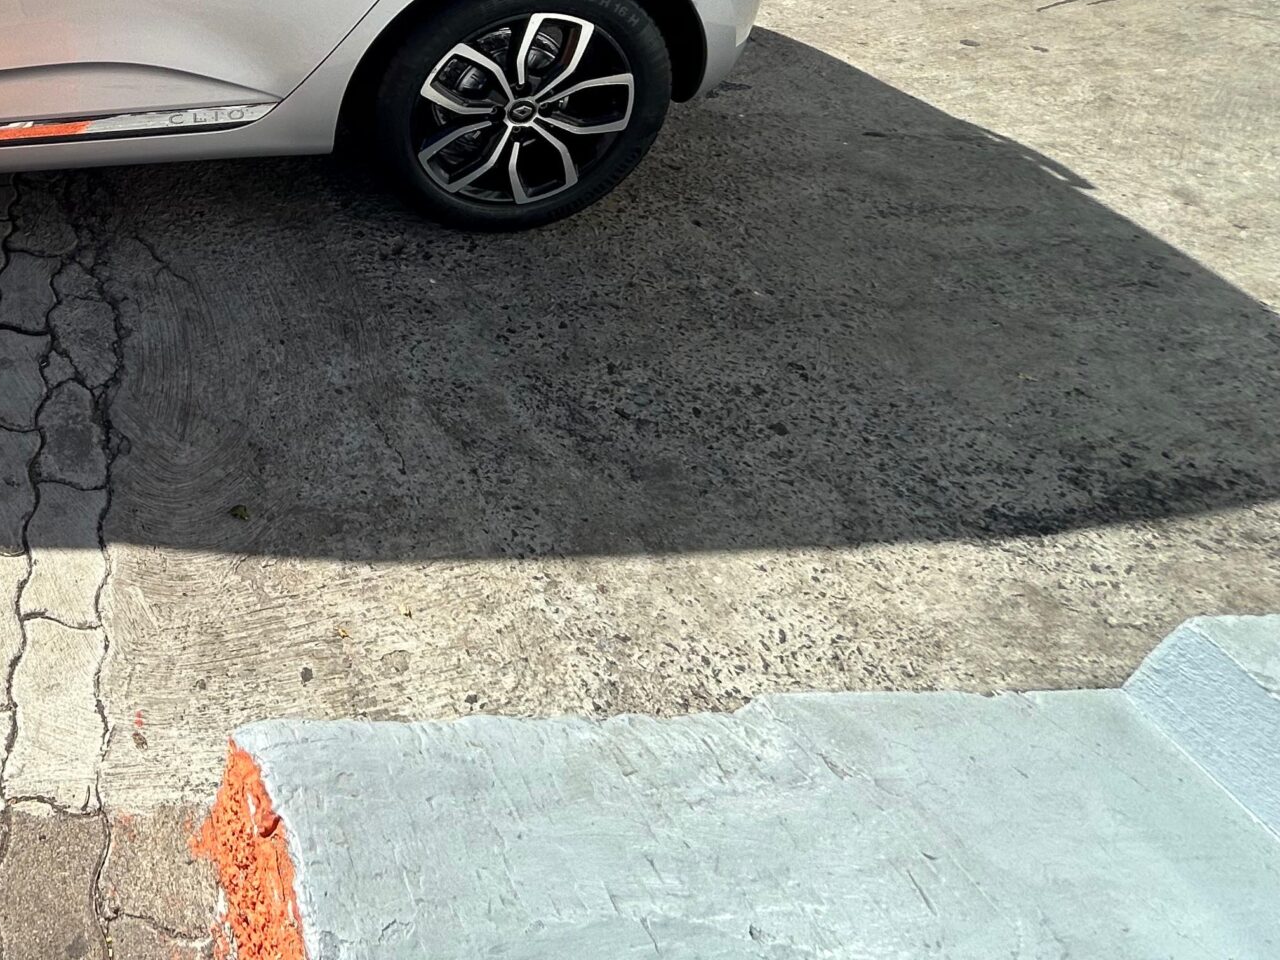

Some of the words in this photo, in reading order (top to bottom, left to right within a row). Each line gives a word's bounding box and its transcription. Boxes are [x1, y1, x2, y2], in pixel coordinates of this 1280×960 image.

[613, 3, 628, 19] 16
[629, 14, 641, 27] H
[169, 109, 245, 125] CLIO
